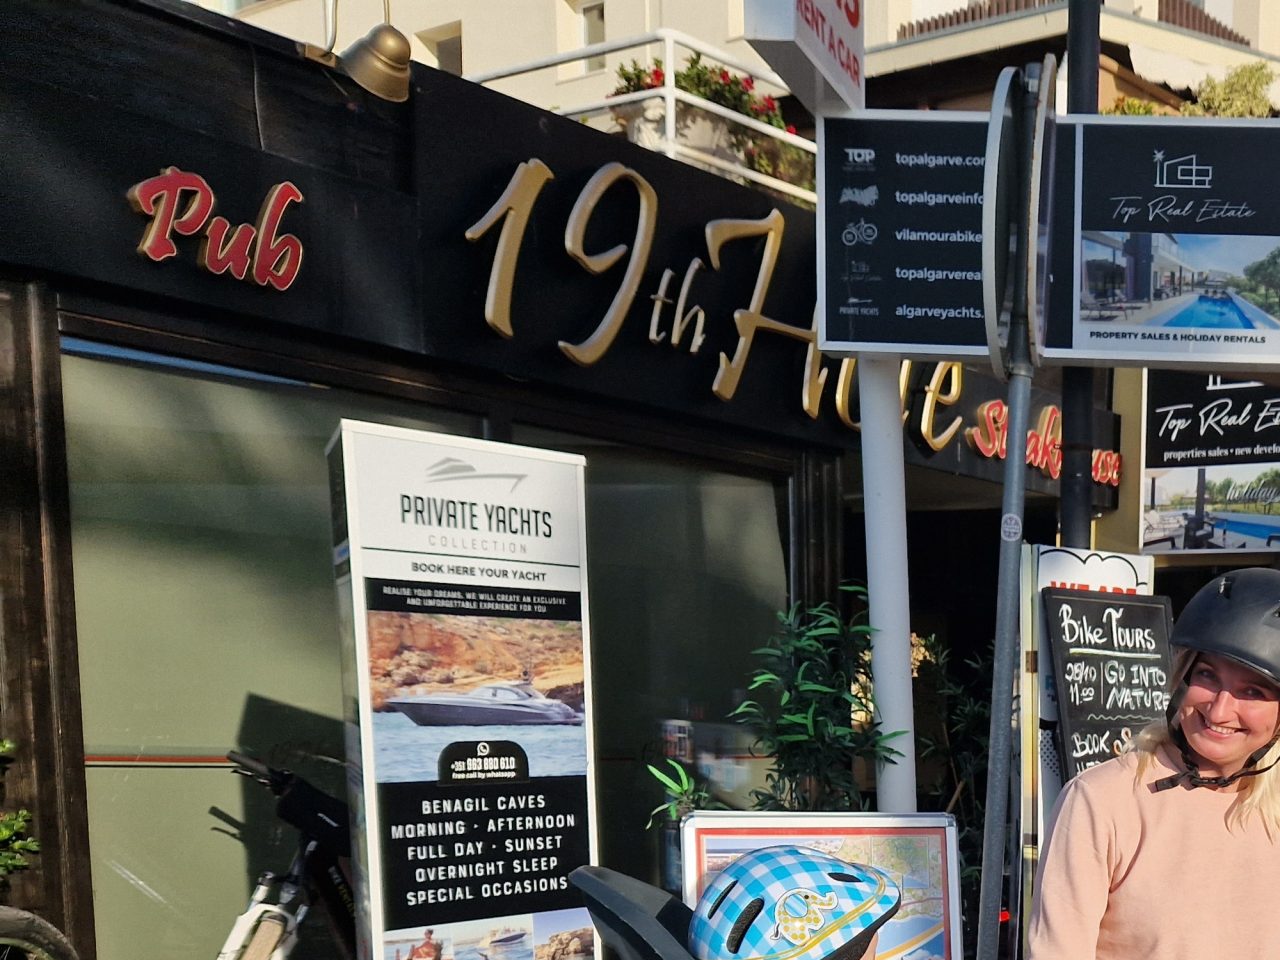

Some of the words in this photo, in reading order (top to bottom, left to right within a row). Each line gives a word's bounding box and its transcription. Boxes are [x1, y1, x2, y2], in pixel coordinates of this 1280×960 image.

[828, 24, 837, 60] A
[838, 36, 861, 90] CAR
[844, 148, 876, 163] TOP
[1109, 196, 1141, 223] Top
[1147, 194, 1193, 223] Real
[1196, 198, 1257, 223] Estate
[127, 165, 304, 292] Pub
[1089, 331, 1139, 341] PROPERTY
[1141, 332, 1171, 342] SALES
[1180, 333, 1223, 343] HOLIDAY
[1223, 335, 1267, 344] RENTALS
[1155, 403, 1193, 442] Top
[1198, 397, 1253, 436] Real
[1163, 447, 1207, 462] properties
[1207, 446, 1229, 458] sales
[1234, 445, 1252, 456] new
[400, 493, 480, 531] PRIVATE
[484, 502, 553, 538] YACHTS
[428, 534, 528, 554] COLLECTION
[411, 561, 445, 574] BOOK
[447, 564, 476, 577] HERE
[478, 566, 509, 580] YOUR
[511, 569, 547, 583] YACHT
[383, 586, 412, 597] REALISE
[478, 592, 495, 602] WILL
[496, 594, 521, 603] CREATE
[532, 596, 567, 606] EXCLUSIVE
[1058, 602, 1108, 645] Bike
[1065, 661, 1097, 683] 28/10
[1104, 660, 1125, 685] GO
[1130, 664, 1167, 687] INTO
[1106, 686, 1171, 711] NATURE
[1071, 730, 1110, 758] BOOK
[421, 797, 489, 815] BENAGIL
[497, 794, 546, 811] CAVES
[391, 820, 466, 840] MORNING
[487, 813, 576, 833] AFTERNOON
[407, 844, 447, 861] FULL
[454, 841, 484, 857] DAY
[504, 835, 563, 852] SUNSET
[415, 861, 505, 883] OVERNIGHT
[513, 856, 558, 873] SLEEP
[406, 886, 474, 906] SPECIAL
[481, 875, 568, 898] OCCASIONS
